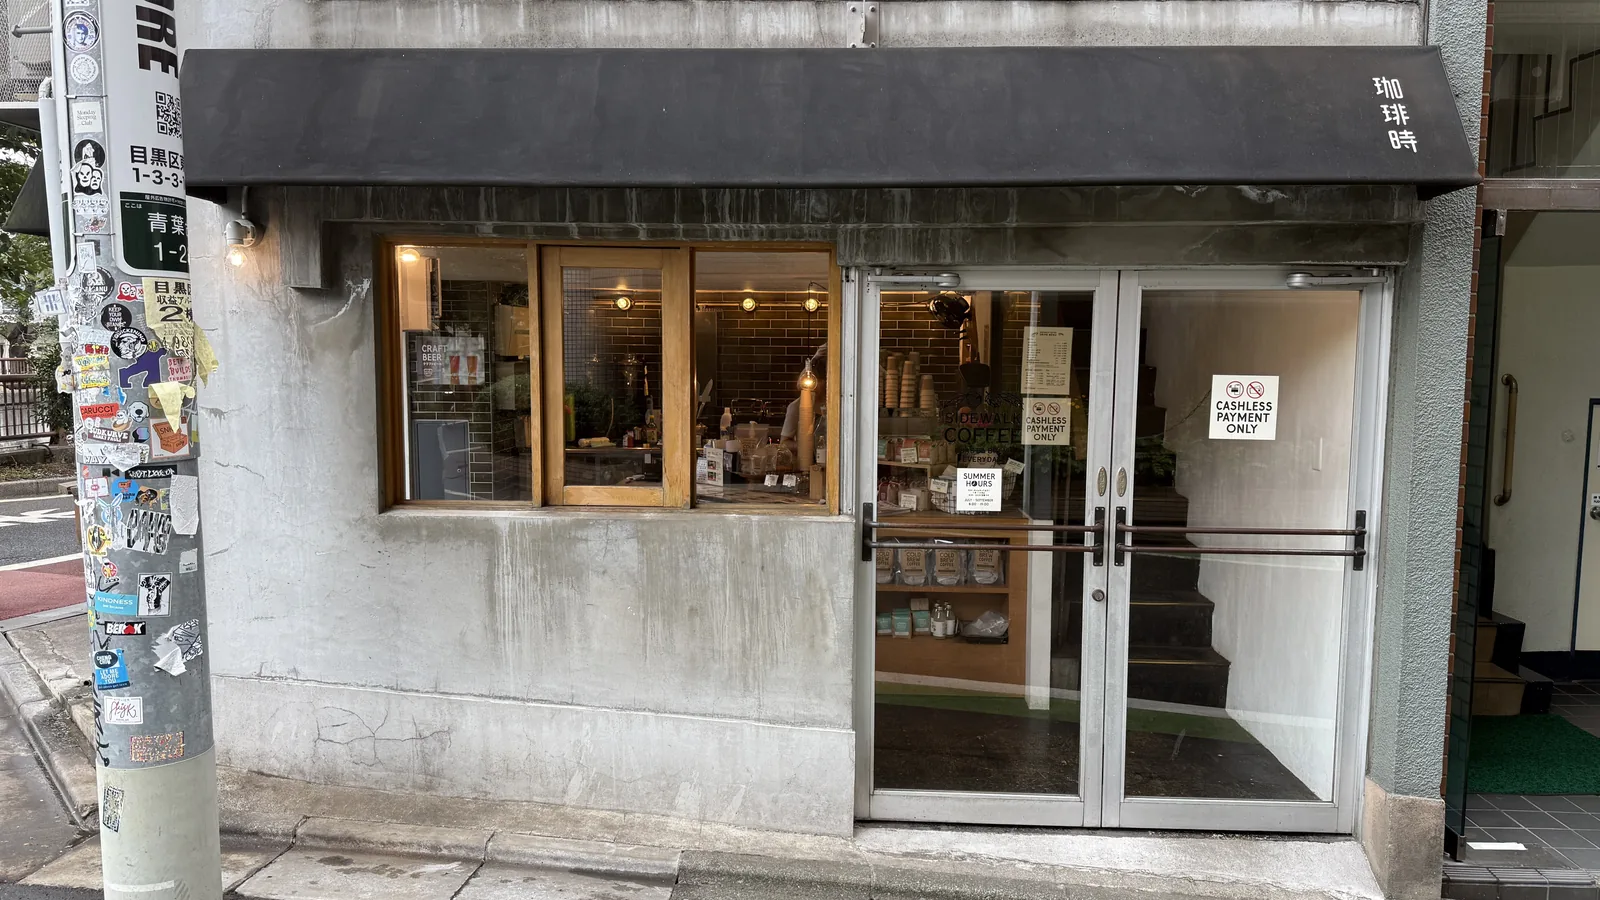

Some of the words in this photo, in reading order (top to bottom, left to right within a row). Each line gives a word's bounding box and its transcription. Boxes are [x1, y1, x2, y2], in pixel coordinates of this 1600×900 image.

[136, 0, 178, 79] RE
[1372, 76, 1418, 153] 珈琲時
[147, 212, 187, 236] 青葉
[421, 344, 447, 353] CRAFT
[422, 353, 442, 361] BEER
[1216, 401, 1272, 411] CASHLESS
[945, 412, 1020, 424] SIDEWALK
[1217, 412, 1270, 422] PAYMENT
[1026, 425, 1065, 433] PAYMENT
[1226, 424, 1258, 434] ONLY
[944, 428, 1021, 443] COFFEE
[1033, 433, 1057, 441] ONLY
[97, 597, 133, 605] KINDNESS
